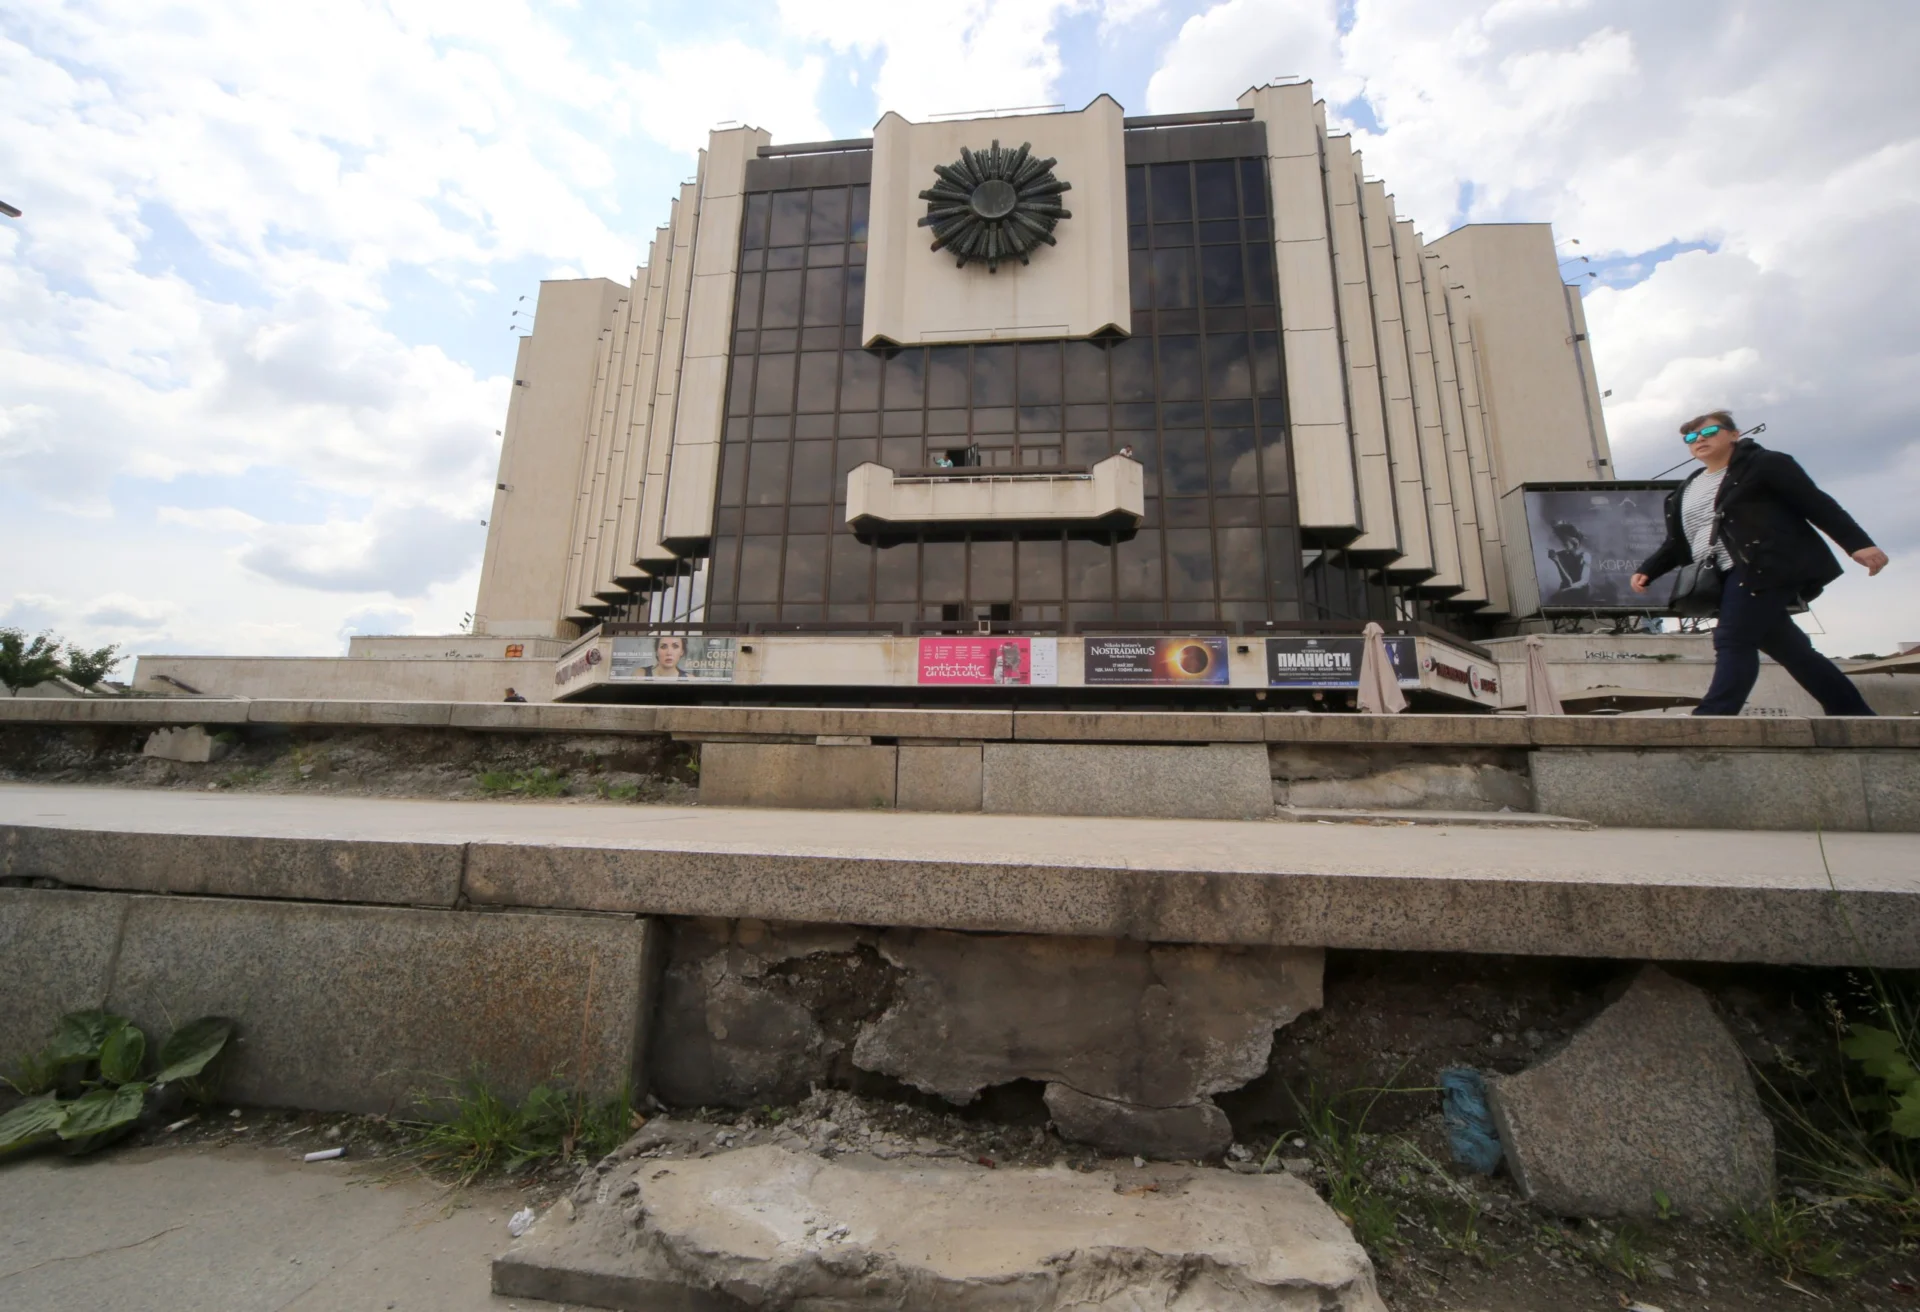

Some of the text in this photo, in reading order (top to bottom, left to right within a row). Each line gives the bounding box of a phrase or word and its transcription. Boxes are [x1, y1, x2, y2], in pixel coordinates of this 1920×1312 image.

[1598, 559, 1644, 571] КОРАБ
[706, 651, 733, 659] СОНЯ
[1277, 653, 1351, 667] ПИАНИСТИ
